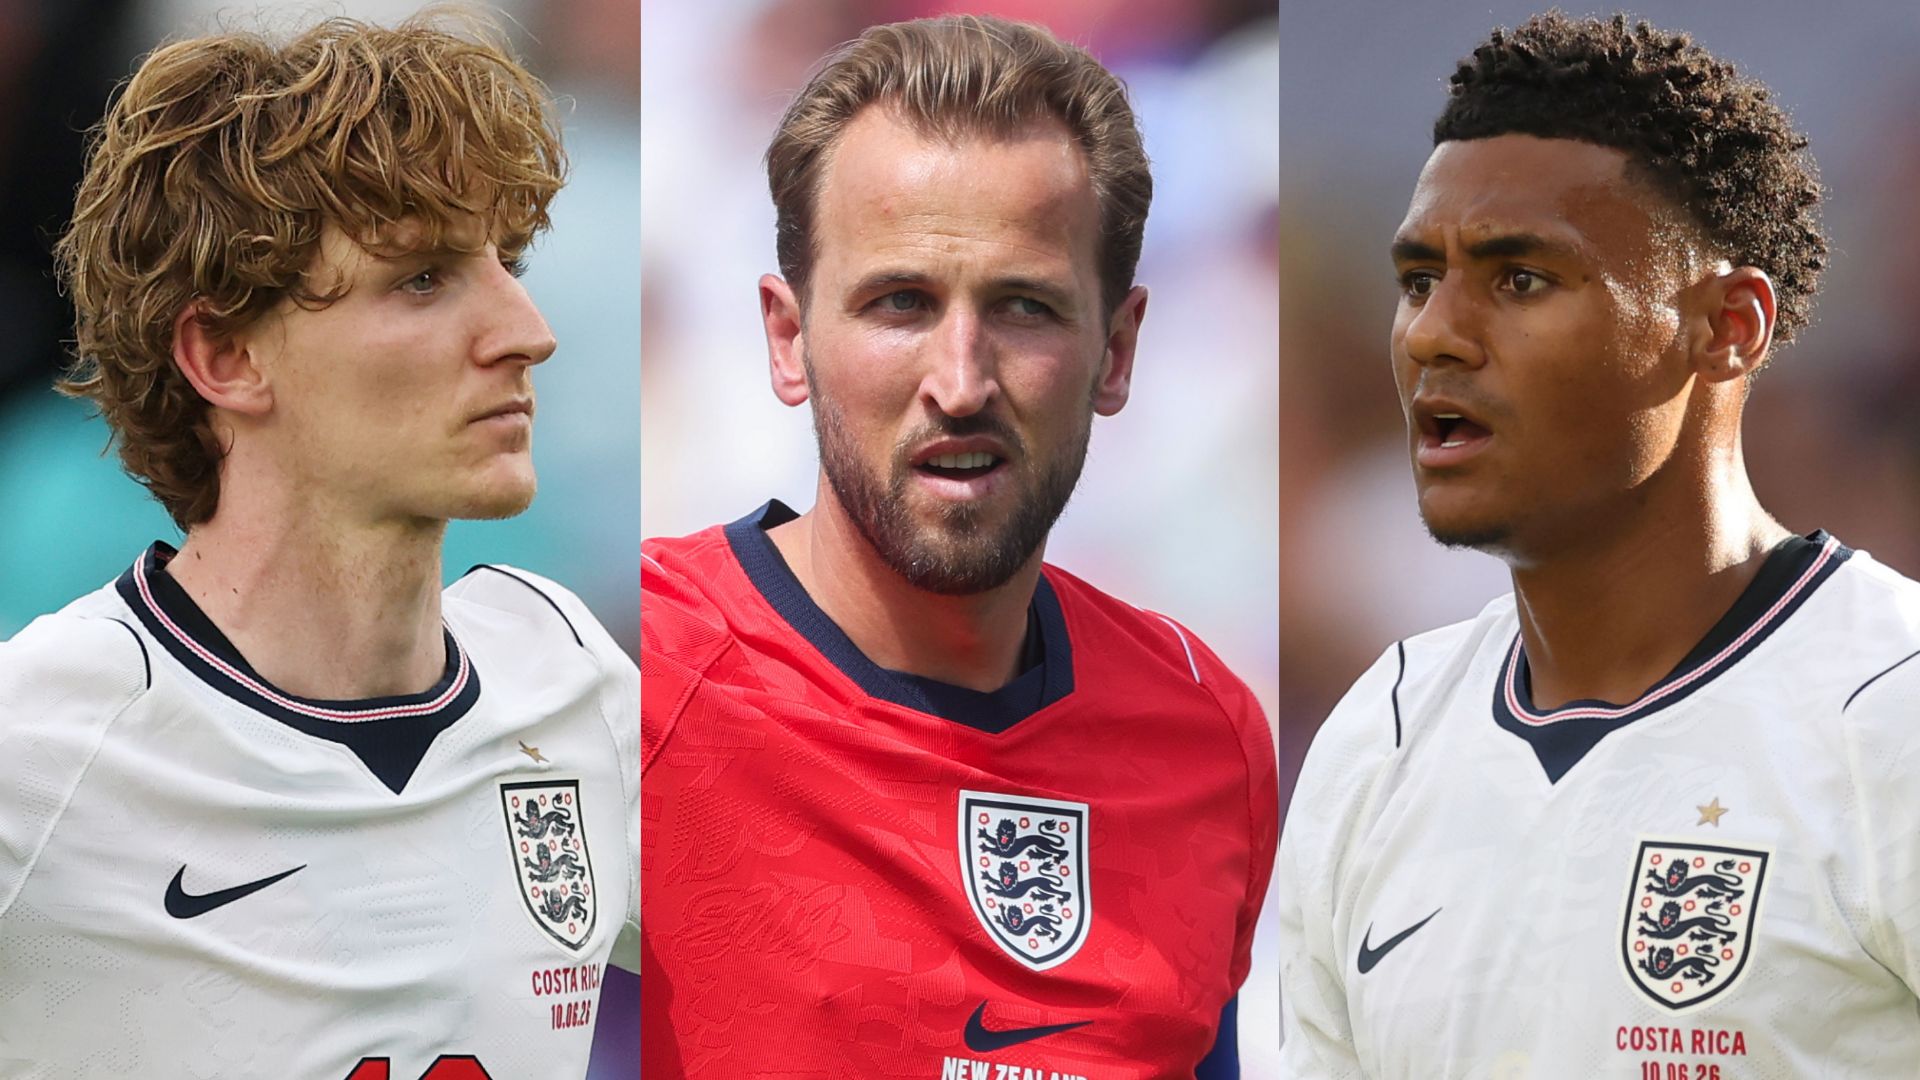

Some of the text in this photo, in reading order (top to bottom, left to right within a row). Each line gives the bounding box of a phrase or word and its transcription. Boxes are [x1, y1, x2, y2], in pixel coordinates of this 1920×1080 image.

[532, 967, 578, 996] COSTA
[551, 999, 591, 1030] 10.06.26
[1616, 1026, 1746, 1055] COSTA RICA
[941, 1056, 990, 1080] NEW
[1641, 1061, 1720, 1080] 100626
